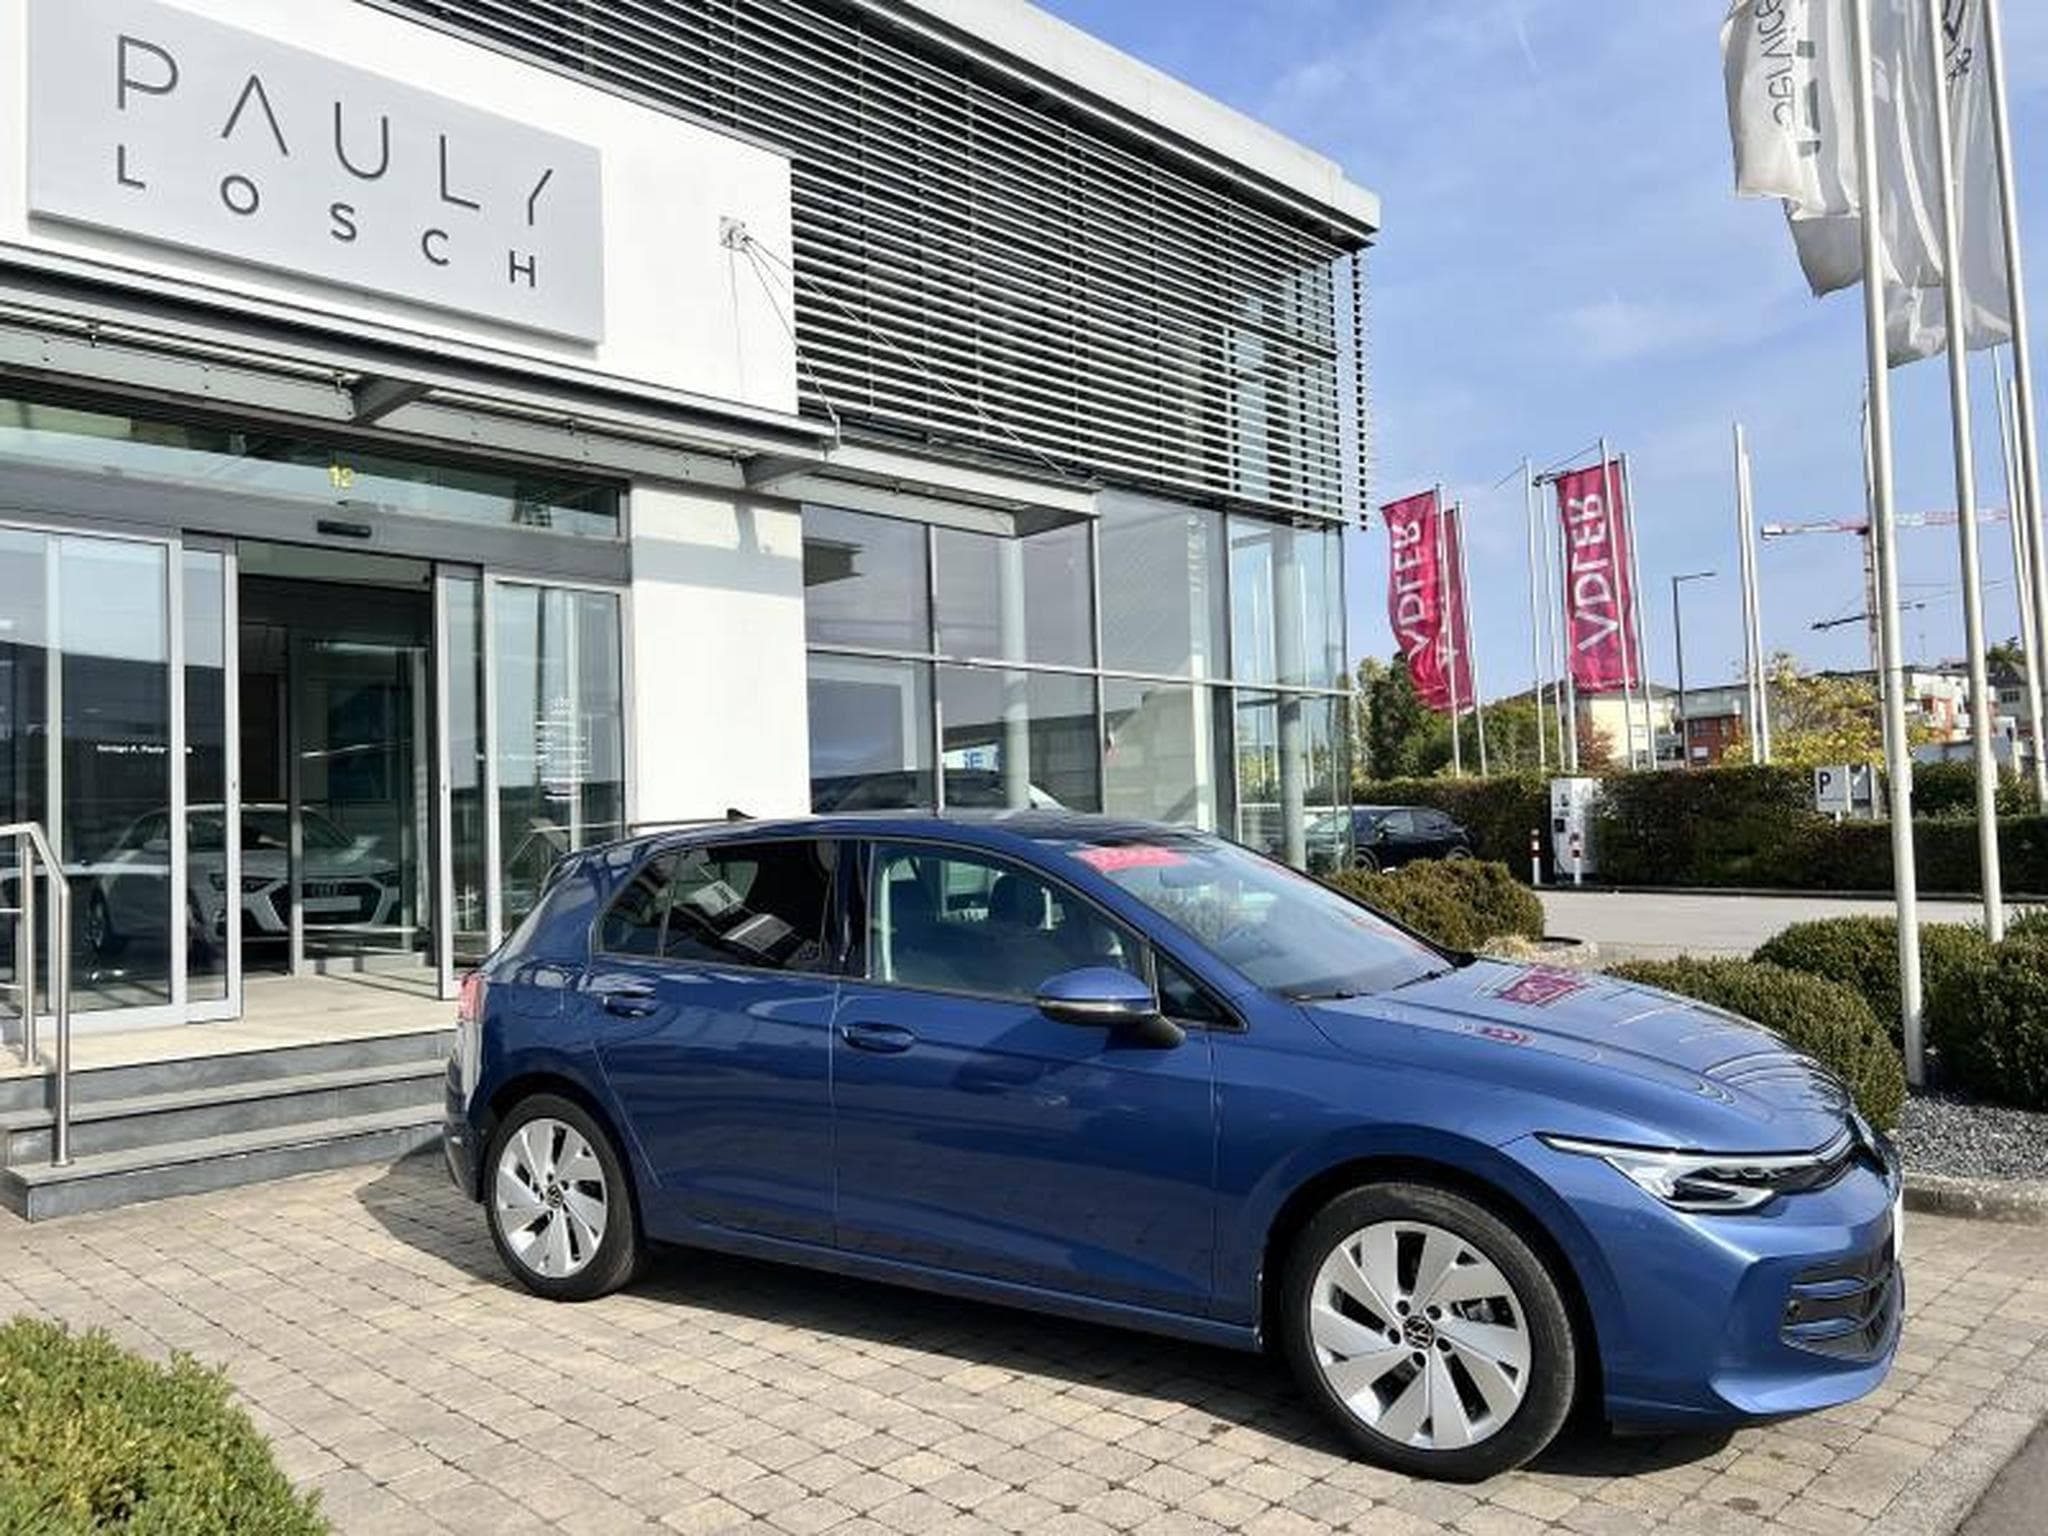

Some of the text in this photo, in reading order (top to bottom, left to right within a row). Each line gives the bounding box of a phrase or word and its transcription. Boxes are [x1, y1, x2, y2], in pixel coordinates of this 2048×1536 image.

[117, 34, 553, 225] PAULY
[117, 144, 537, 287] LOSCH
[1818, 771, 1831, 794] P
